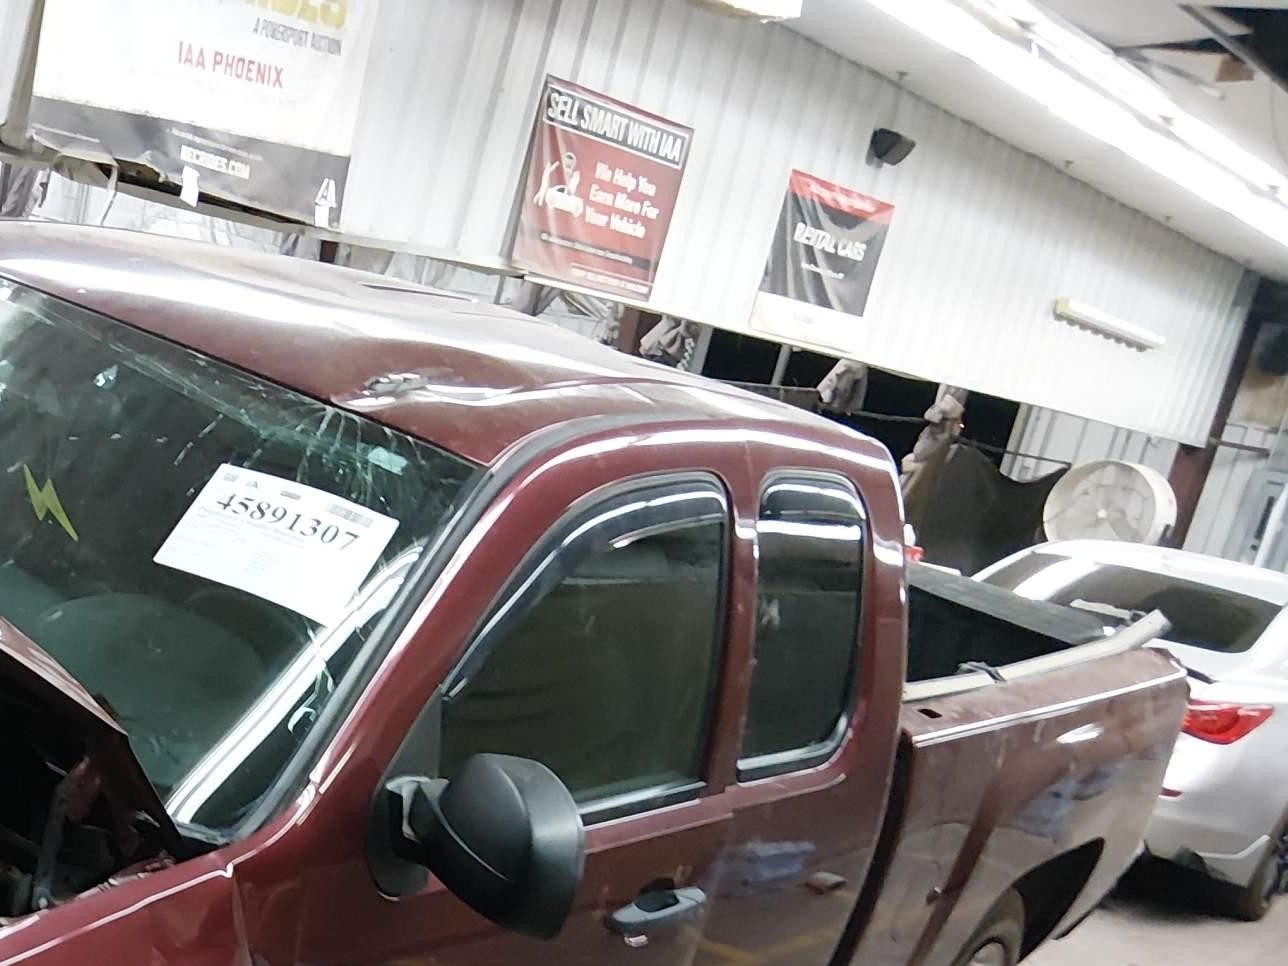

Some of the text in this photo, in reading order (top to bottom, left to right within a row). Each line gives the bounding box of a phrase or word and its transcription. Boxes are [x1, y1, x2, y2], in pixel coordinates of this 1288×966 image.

[178, 41, 285, 89] IAA PHOENIX
[548, 93, 681, 163] SELL SMART WITH IAA
[612, 168, 637, 193] Help
[638, 175, 656, 196] You
[589, 184, 660, 220] Earn More For
[585, 206, 646, 239] Your Vehicle
[793, 222, 867, 261] RENTAL CARS
[216, 493, 360, 550] 45891307
